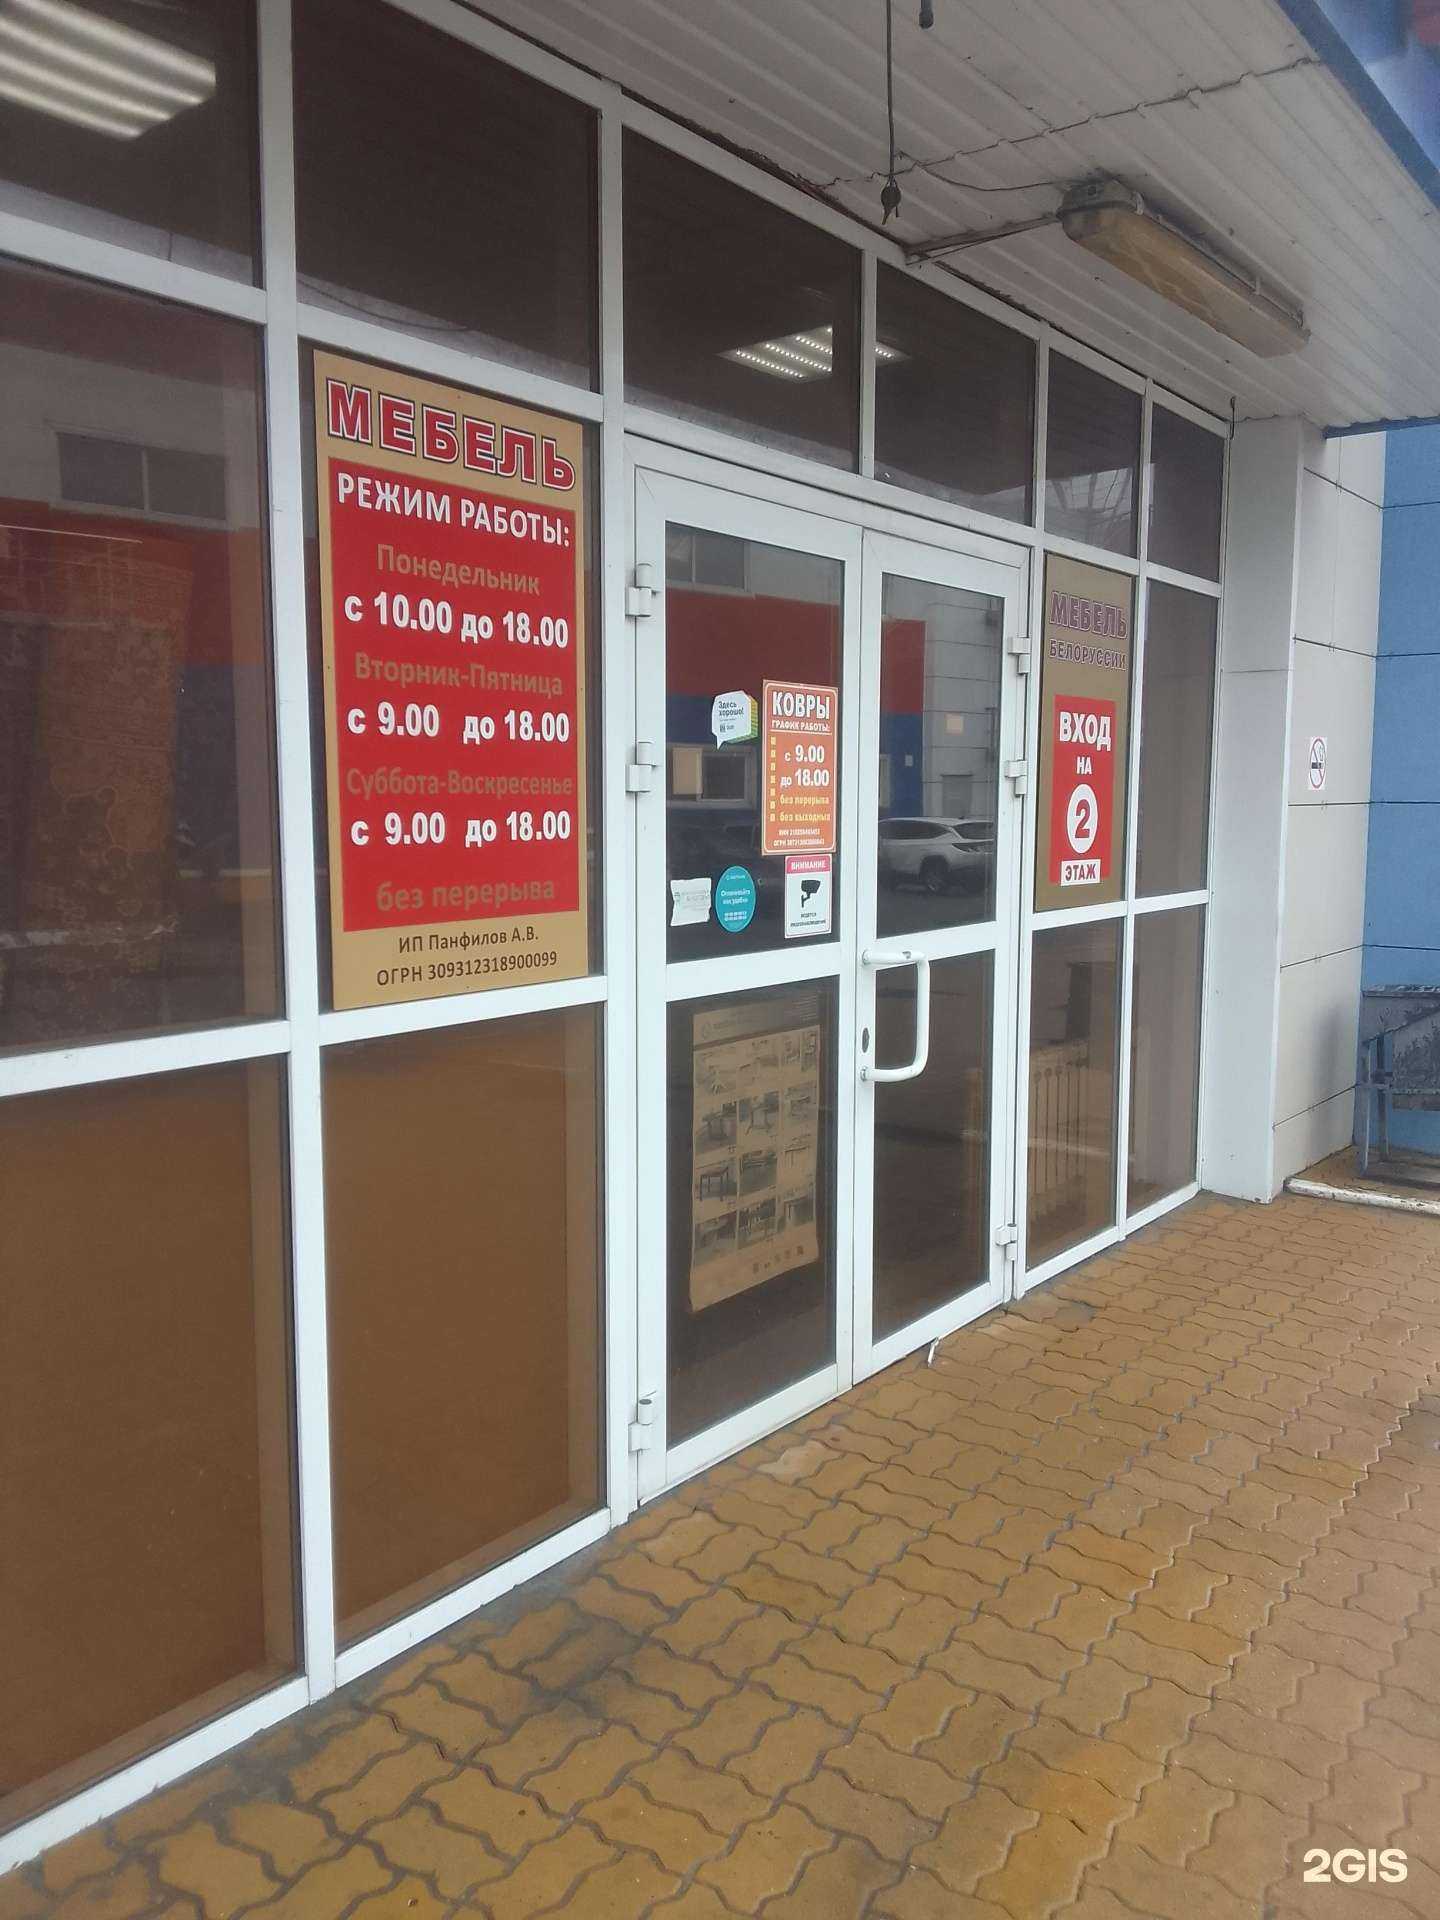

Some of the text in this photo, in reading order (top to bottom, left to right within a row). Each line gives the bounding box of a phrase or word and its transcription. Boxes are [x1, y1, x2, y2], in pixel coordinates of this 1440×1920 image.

[326, 377, 575, 491] МЕБЕЛЬ
[338, 473, 570, 547] РЕЖИМ РАБОТЫ:
[377, 544, 540, 595] Понедельник
[344, 592, 569, 648] с 10.00 до 18.00
[1049, 590, 1128, 639] МЕБЕЛЬ
[1049, 638, 1127, 670] БЕЛОРУССИИ
[355, 652, 562, 698] Вторник-Пятница
[772, 691, 830, 720] КОВРЫ
[348, 702, 570, 745] с 9.00 до 18.00
[772, 720, 799, 730] ГРАФИК
[1059, 711, 1111, 751] ВХОД
[784, 745, 825, 763] с 9.00
[1076, 756, 1092, 775] НА
[346, 766, 573, 800] Суббота-Воскресенье
[780, 769, 830, 787] до 18.00
[351, 811, 571, 847] с 9.00 до 18.00
[1075, 799, 1091, 839] 2
[791, 860, 827, 870] ВНИМАНИЕ
[1065, 863, 1096, 882] ЭТАЖ
[376, 880, 555, 911] без перерыва
[399, 926, 539, 953] ИП Панфилов А.В.
[377, 951, 557, 986] ОГРН 309312318900099
